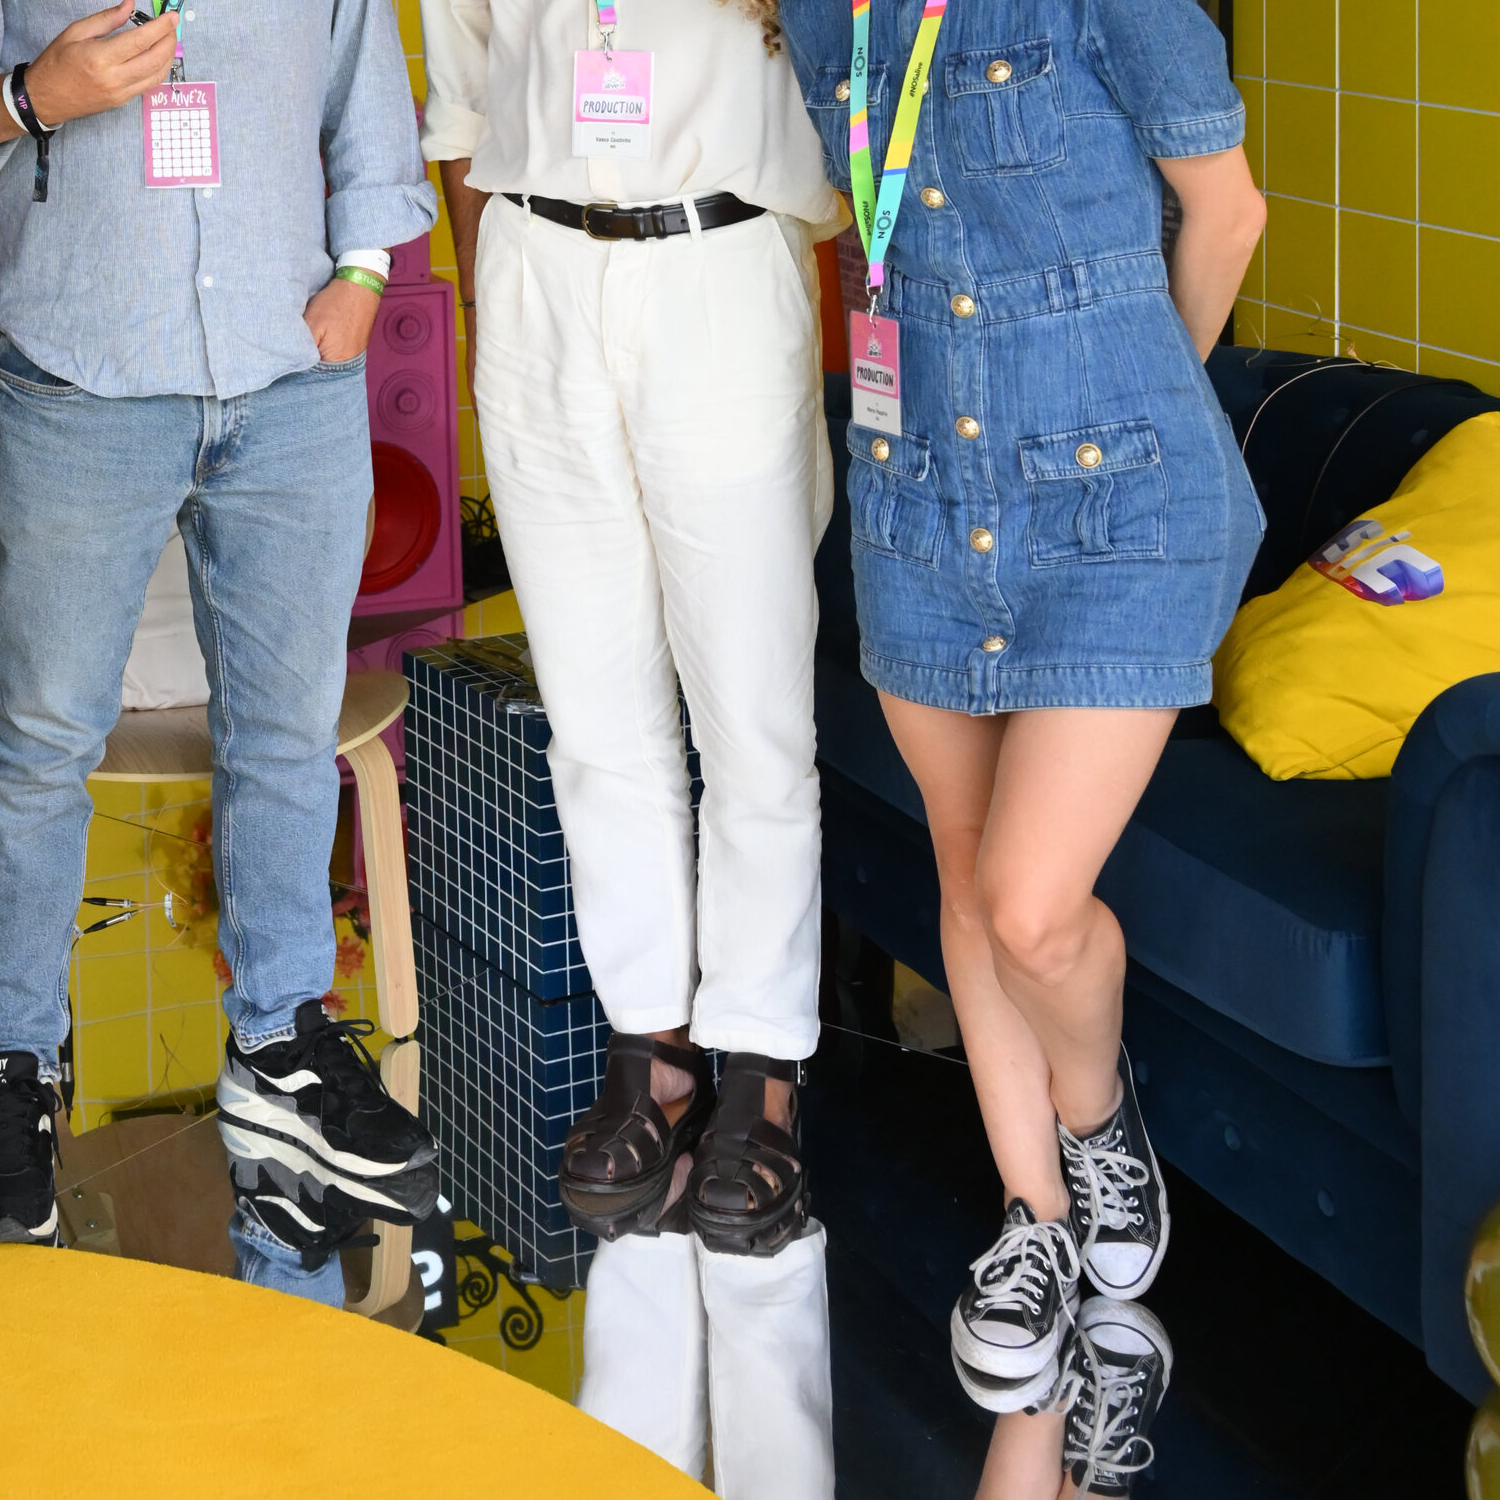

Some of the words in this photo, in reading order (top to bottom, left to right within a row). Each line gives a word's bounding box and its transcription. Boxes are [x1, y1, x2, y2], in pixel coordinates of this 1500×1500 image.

[854, 46, 867, 77] NOS
[909, 61, 924, 99] #NOSalive
[17, 94, 28, 111] VIP
[150, 91, 168, 106] NOS
[583, 100, 643, 115] PRODUCTION
[876, 209, 893, 239] NOS
[857, 365, 894, 387] PRODUCTION
